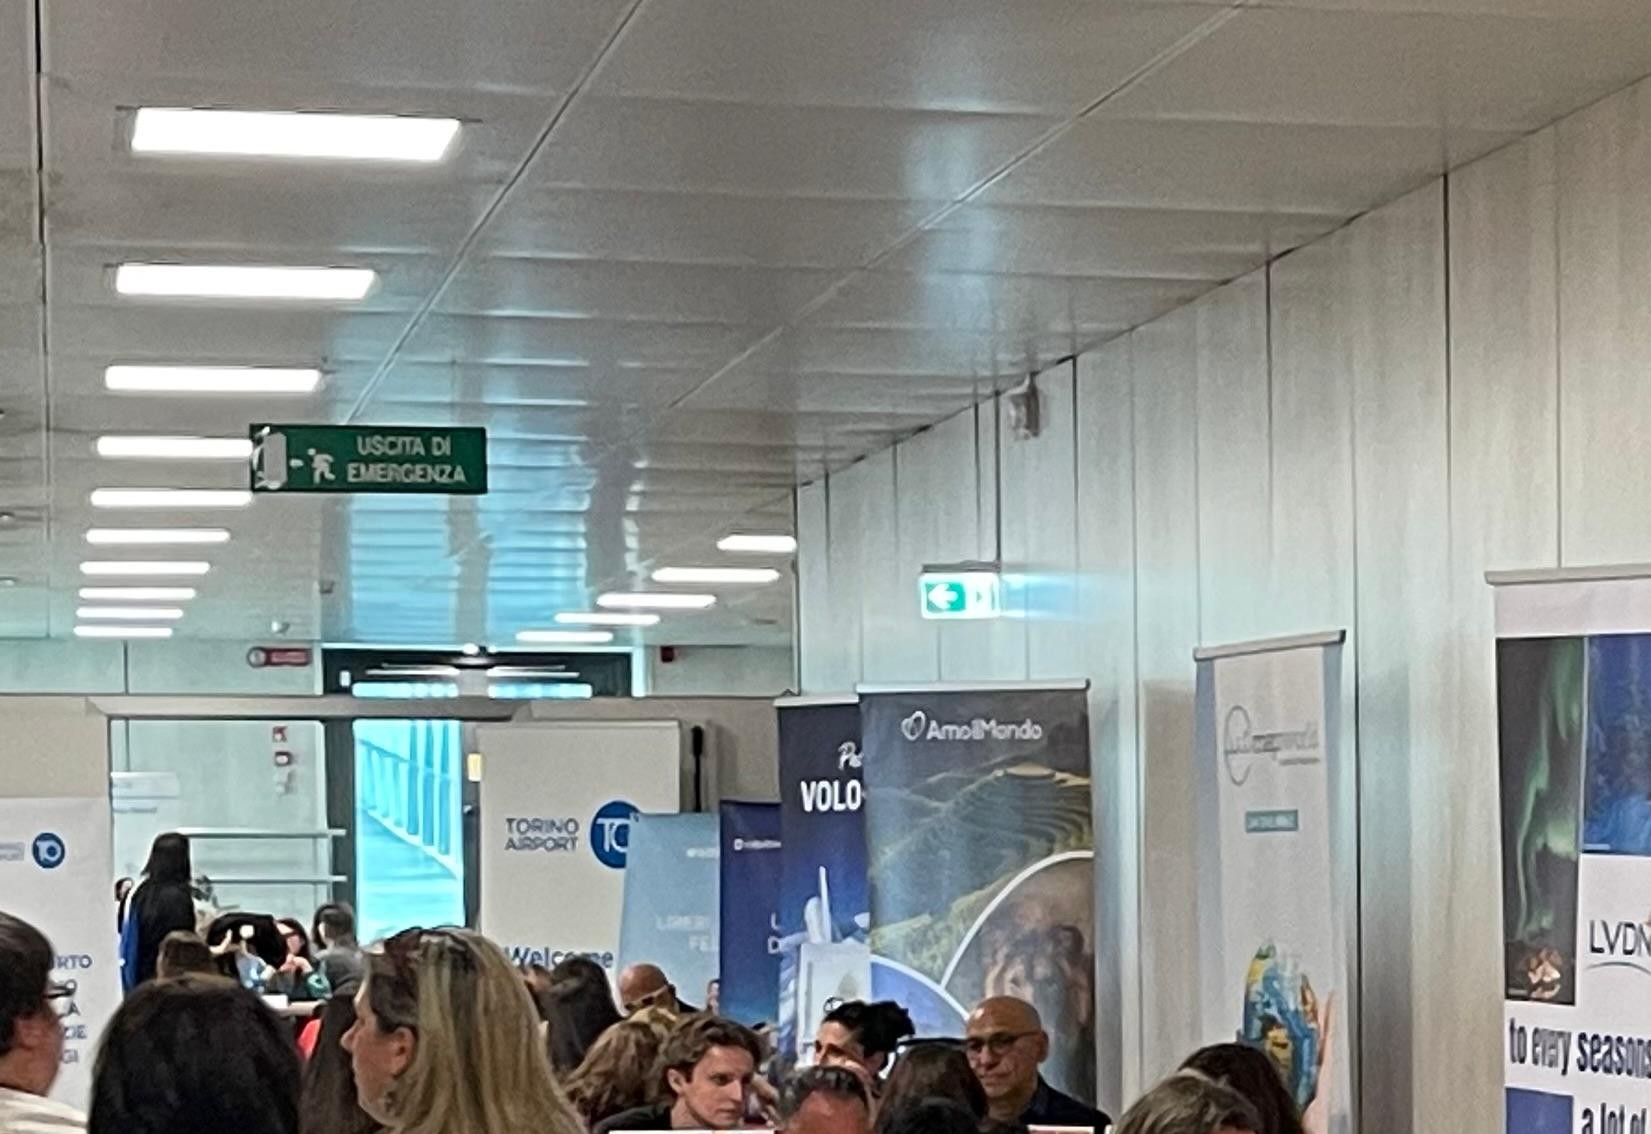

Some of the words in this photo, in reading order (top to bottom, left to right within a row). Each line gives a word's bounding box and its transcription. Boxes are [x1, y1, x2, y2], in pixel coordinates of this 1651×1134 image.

[356, 435, 426, 457] USCITA
[431, 436, 452, 457] DI
[346, 461, 467, 485] EMERGENZA
[800, 778, 862, 813] VOLO
[505, 817, 580, 836] TORINO
[504, 836, 579, 851] AIRPORT
[1509, 1017, 1528, 1065] to
[1532, 1026, 1572, 1077] every
